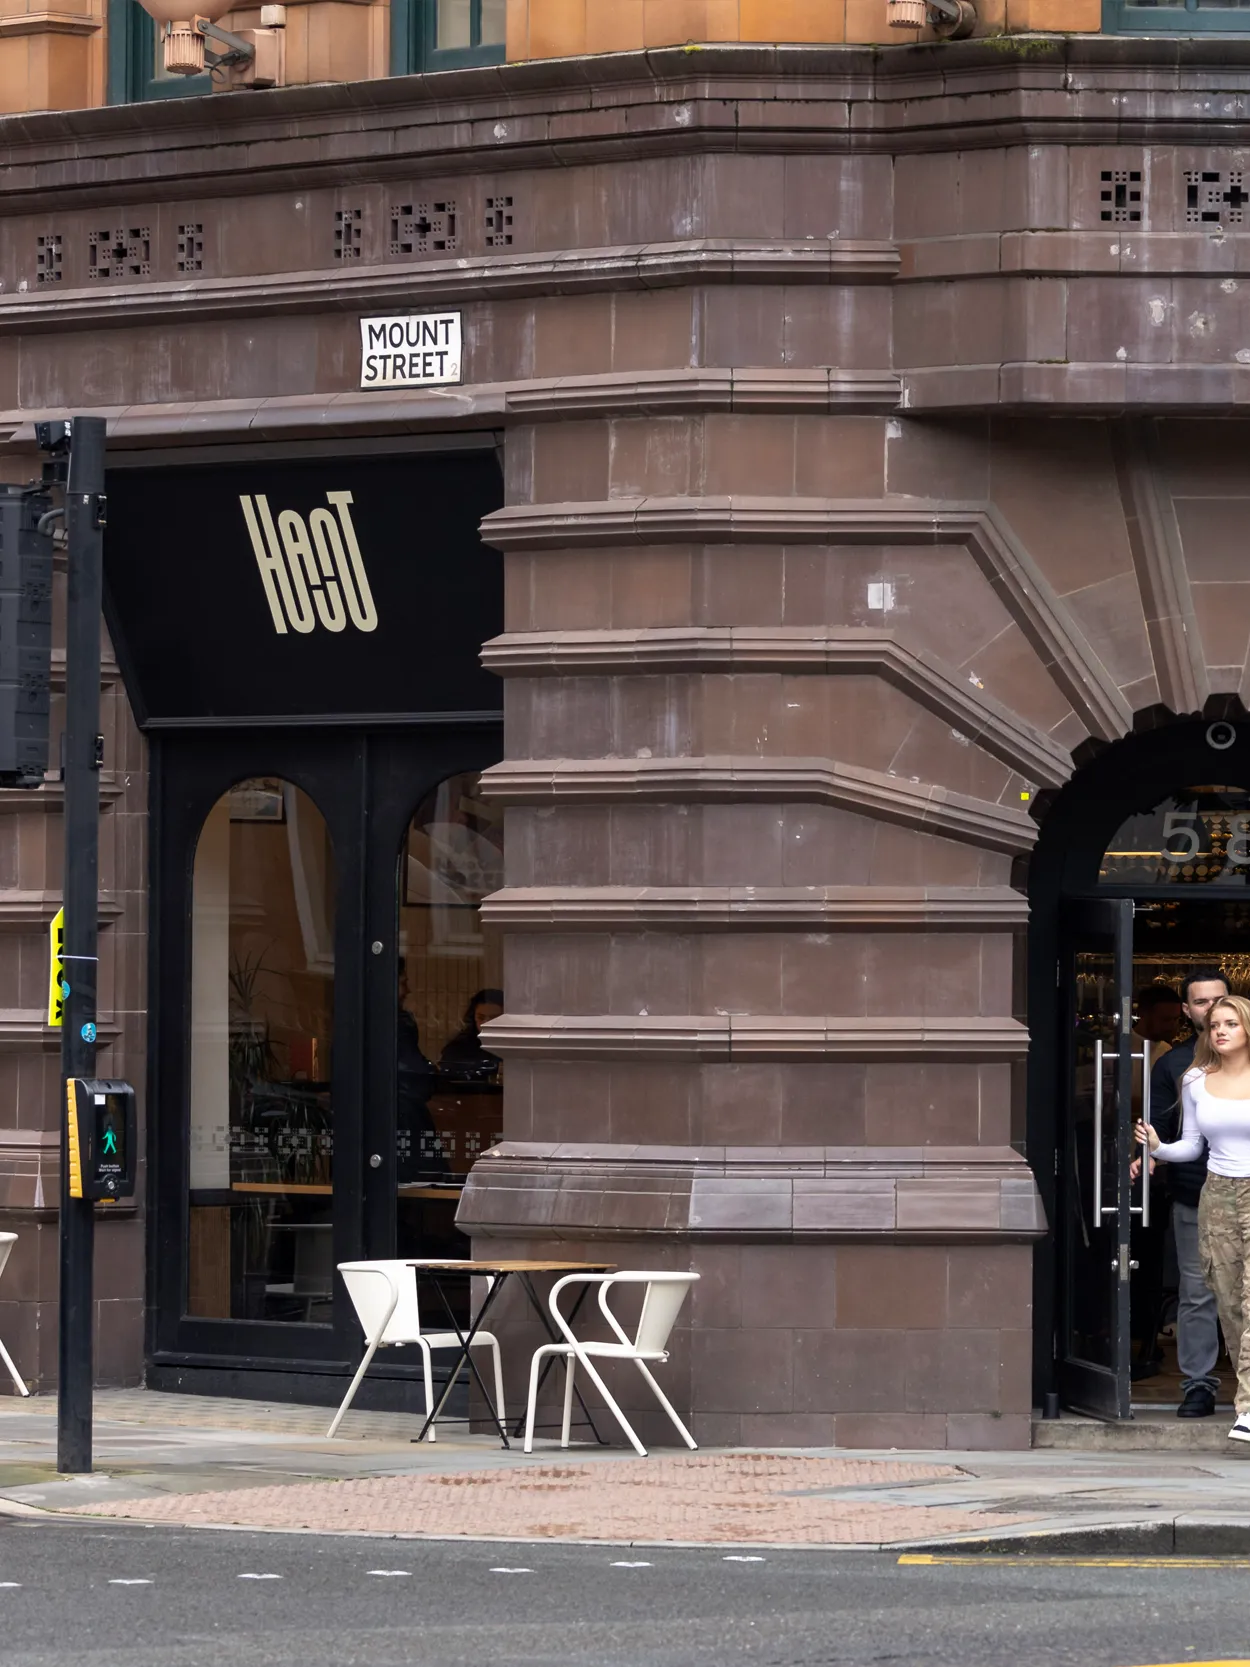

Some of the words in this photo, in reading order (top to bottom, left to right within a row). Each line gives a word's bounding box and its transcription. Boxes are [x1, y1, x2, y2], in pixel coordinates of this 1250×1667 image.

[368, 319, 454, 350] MOUNT
[364, 351, 449, 381] STREET
[450, 362, 458, 377] 2
